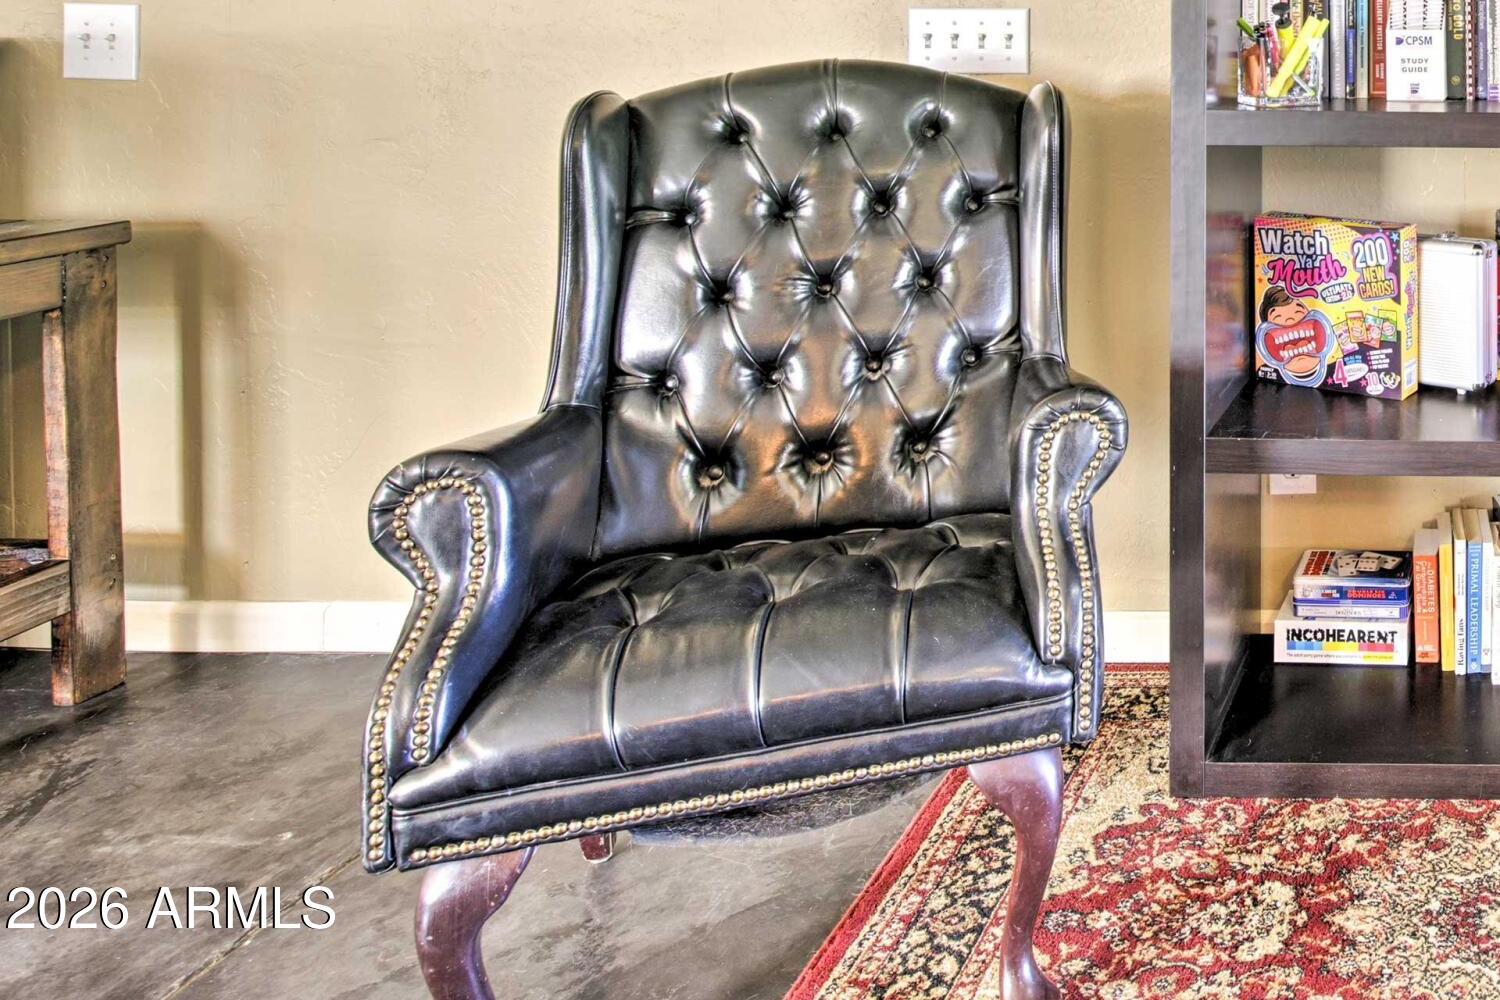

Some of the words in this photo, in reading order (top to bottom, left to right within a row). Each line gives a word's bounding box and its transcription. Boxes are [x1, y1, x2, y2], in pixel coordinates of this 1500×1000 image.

[1406, 36, 1432, 45] CPSM
[1453, 14, 1464, 40] GOLD
[1259, 228, 1330, 256] Watch
[1353, 237, 1388, 267] 200
[1268, 254, 1346, 293] Mouth
[1363, 266, 1386, 283] NEW
[1359, 279, 1395, 298] CARDS!
[1334, 358, 1347, 387] 4
[1367, 372, 1380, 386] 10
[1470, 558, 1479, 594] PRIMAL
[1427, 570, 1435, 613] DIABETES
[1286, 628, 1397, 643] INCOHEARENT
[1470, 597, 1479, 655] LEADERSHIP
[1457, 638, 1465, 666] Raving
